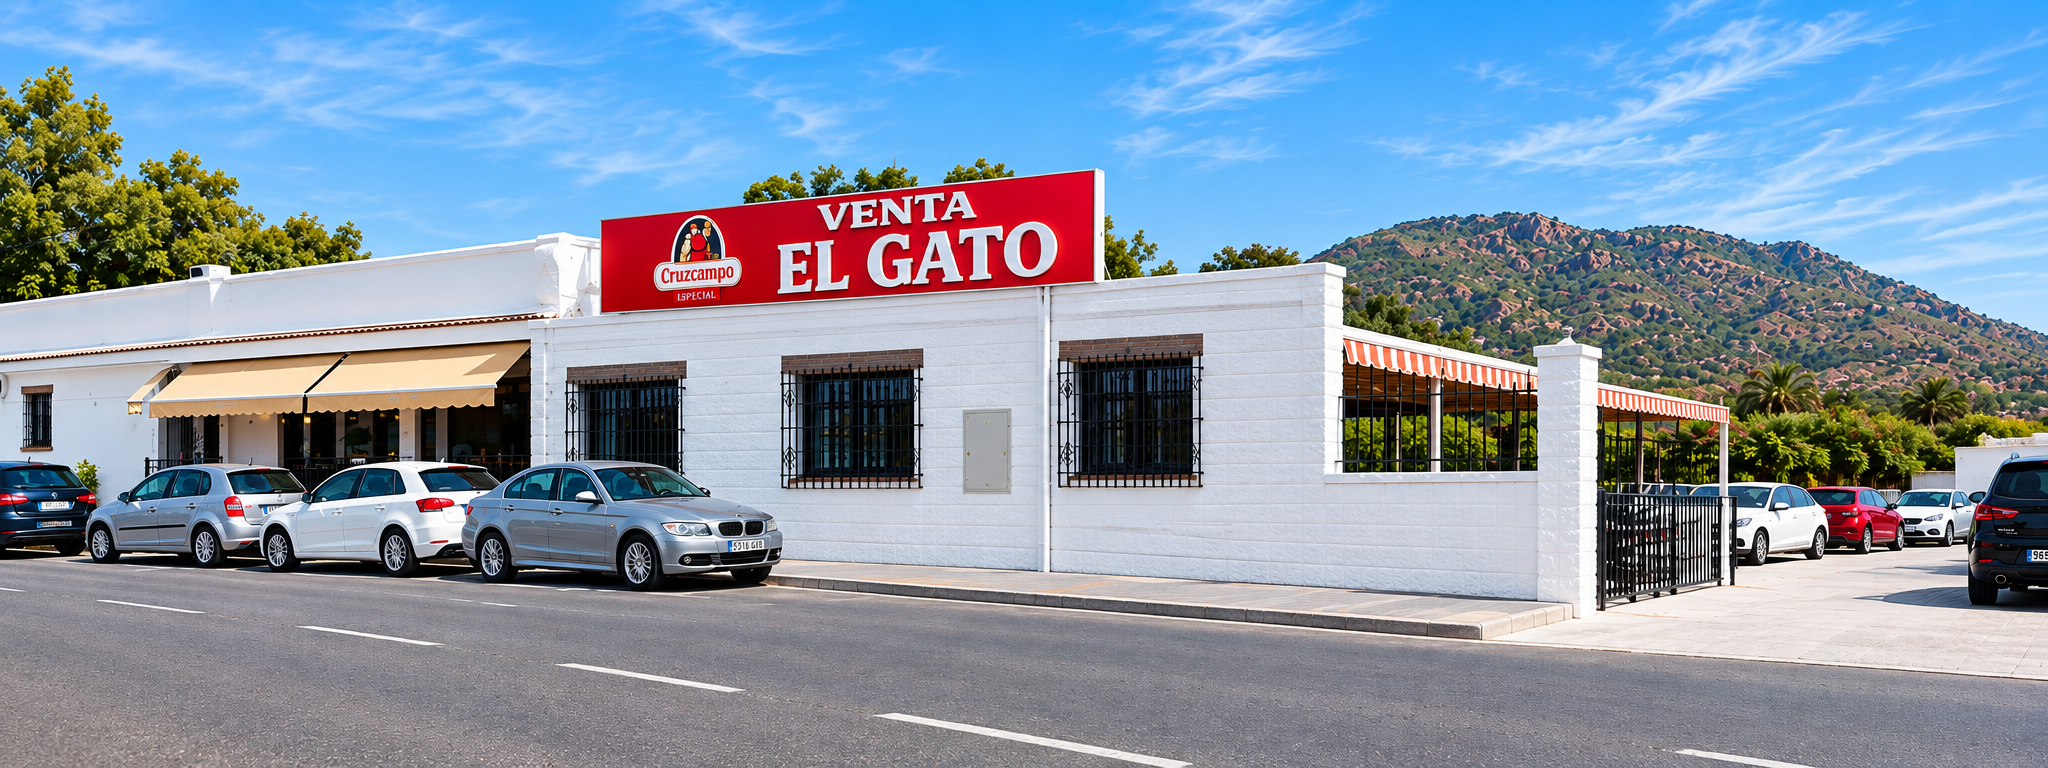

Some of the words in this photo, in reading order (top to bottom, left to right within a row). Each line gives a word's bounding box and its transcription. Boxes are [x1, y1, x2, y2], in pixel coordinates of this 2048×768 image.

[817, 191, 977, 231] VENTA
[777, 240, 850, 294] EL
[867, 221, 1058, 288] GATO
[661, 266, 734, 284] Cruzcampo
[677, 291, 716, 302] ESPECIAL
